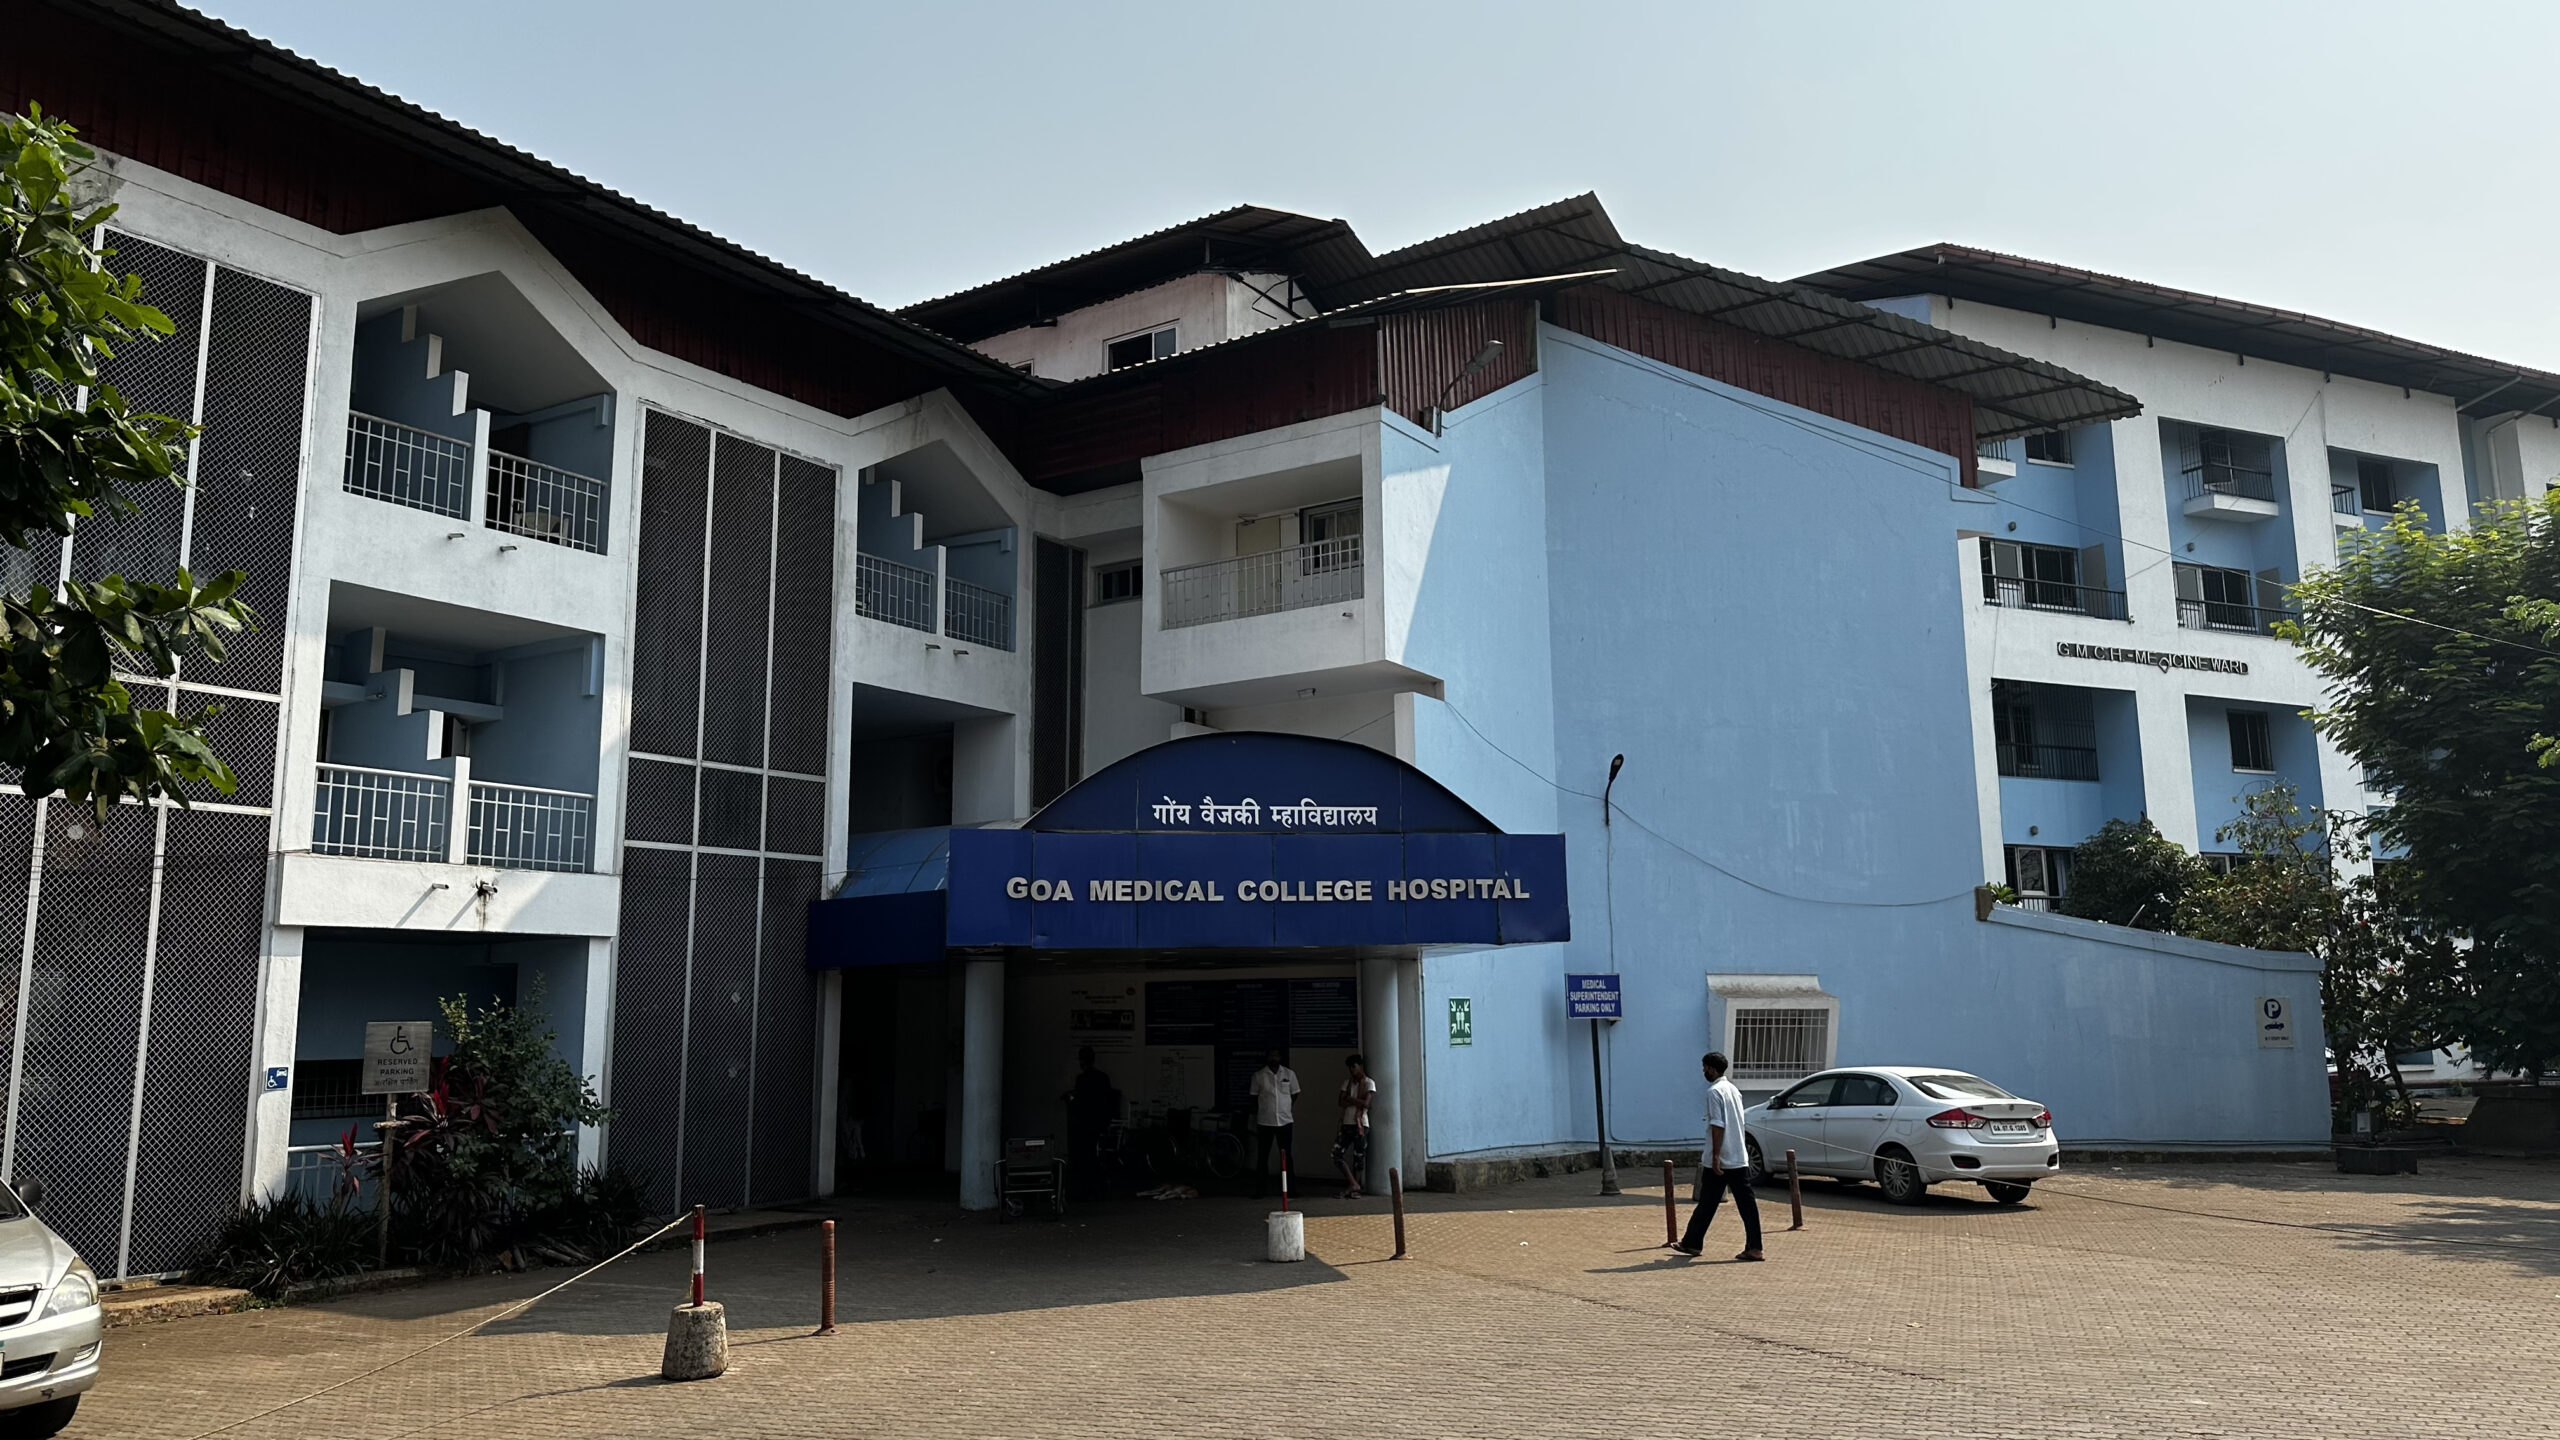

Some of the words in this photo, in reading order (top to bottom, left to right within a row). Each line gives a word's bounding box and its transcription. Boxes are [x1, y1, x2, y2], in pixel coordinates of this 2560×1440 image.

[2211, 656, 2249, 675] WARD
[1152, 796, 1191, 825] गोंय
[1199, 796, 1261, 825] वैजकी
[1007, 877, 1073, 901] GOA
[1090, 879, 1224, 902] MEDICAL
[1237, 880, 1373, 902] COLLEGE
[1388, 878, 1530, 901] HOSPITAL
[1581, 979, 1606, 989] MEDICAL
[1569, 991, 1619, 1001] SUPERINTENDENT
[1574, 1003, 1600, 1013] PARKING
[1601, 1003, 1616, 1013] ONLY
[2267, 1001, 2279, 1017] P
[377, 1058, 418, 1066] RESERVED
